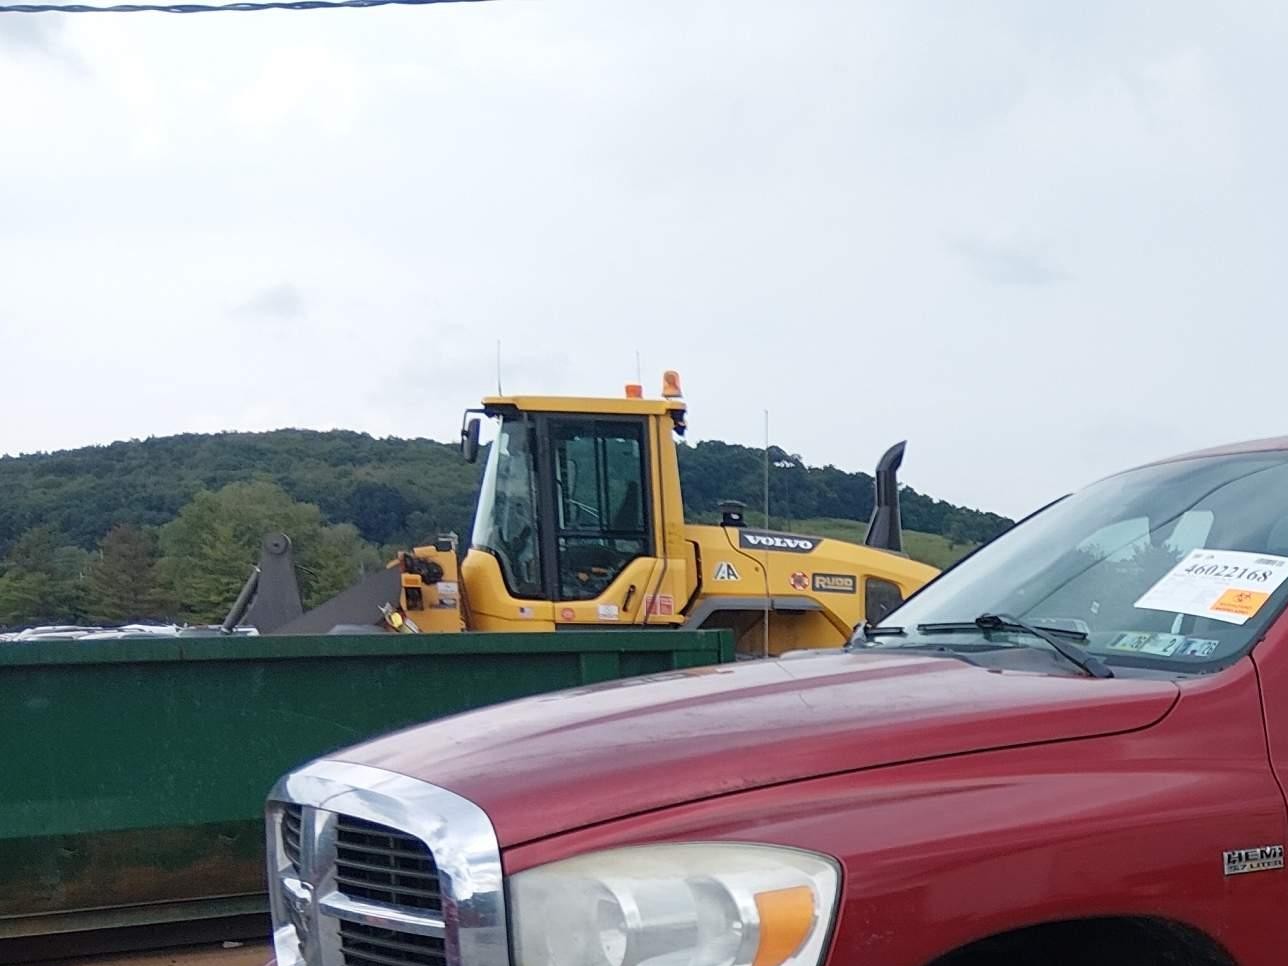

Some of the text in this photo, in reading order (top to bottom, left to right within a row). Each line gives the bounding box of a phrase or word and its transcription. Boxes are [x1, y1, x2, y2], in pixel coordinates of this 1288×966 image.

[744, 535, 813, 549] VOLVO
[1185, 564, 1272, 582] 46022168
[814, 575, 854, 590] RUDD
[1226, 847, 1283, 865] HEMI
[1249, 860, 1282, 869] LITER
